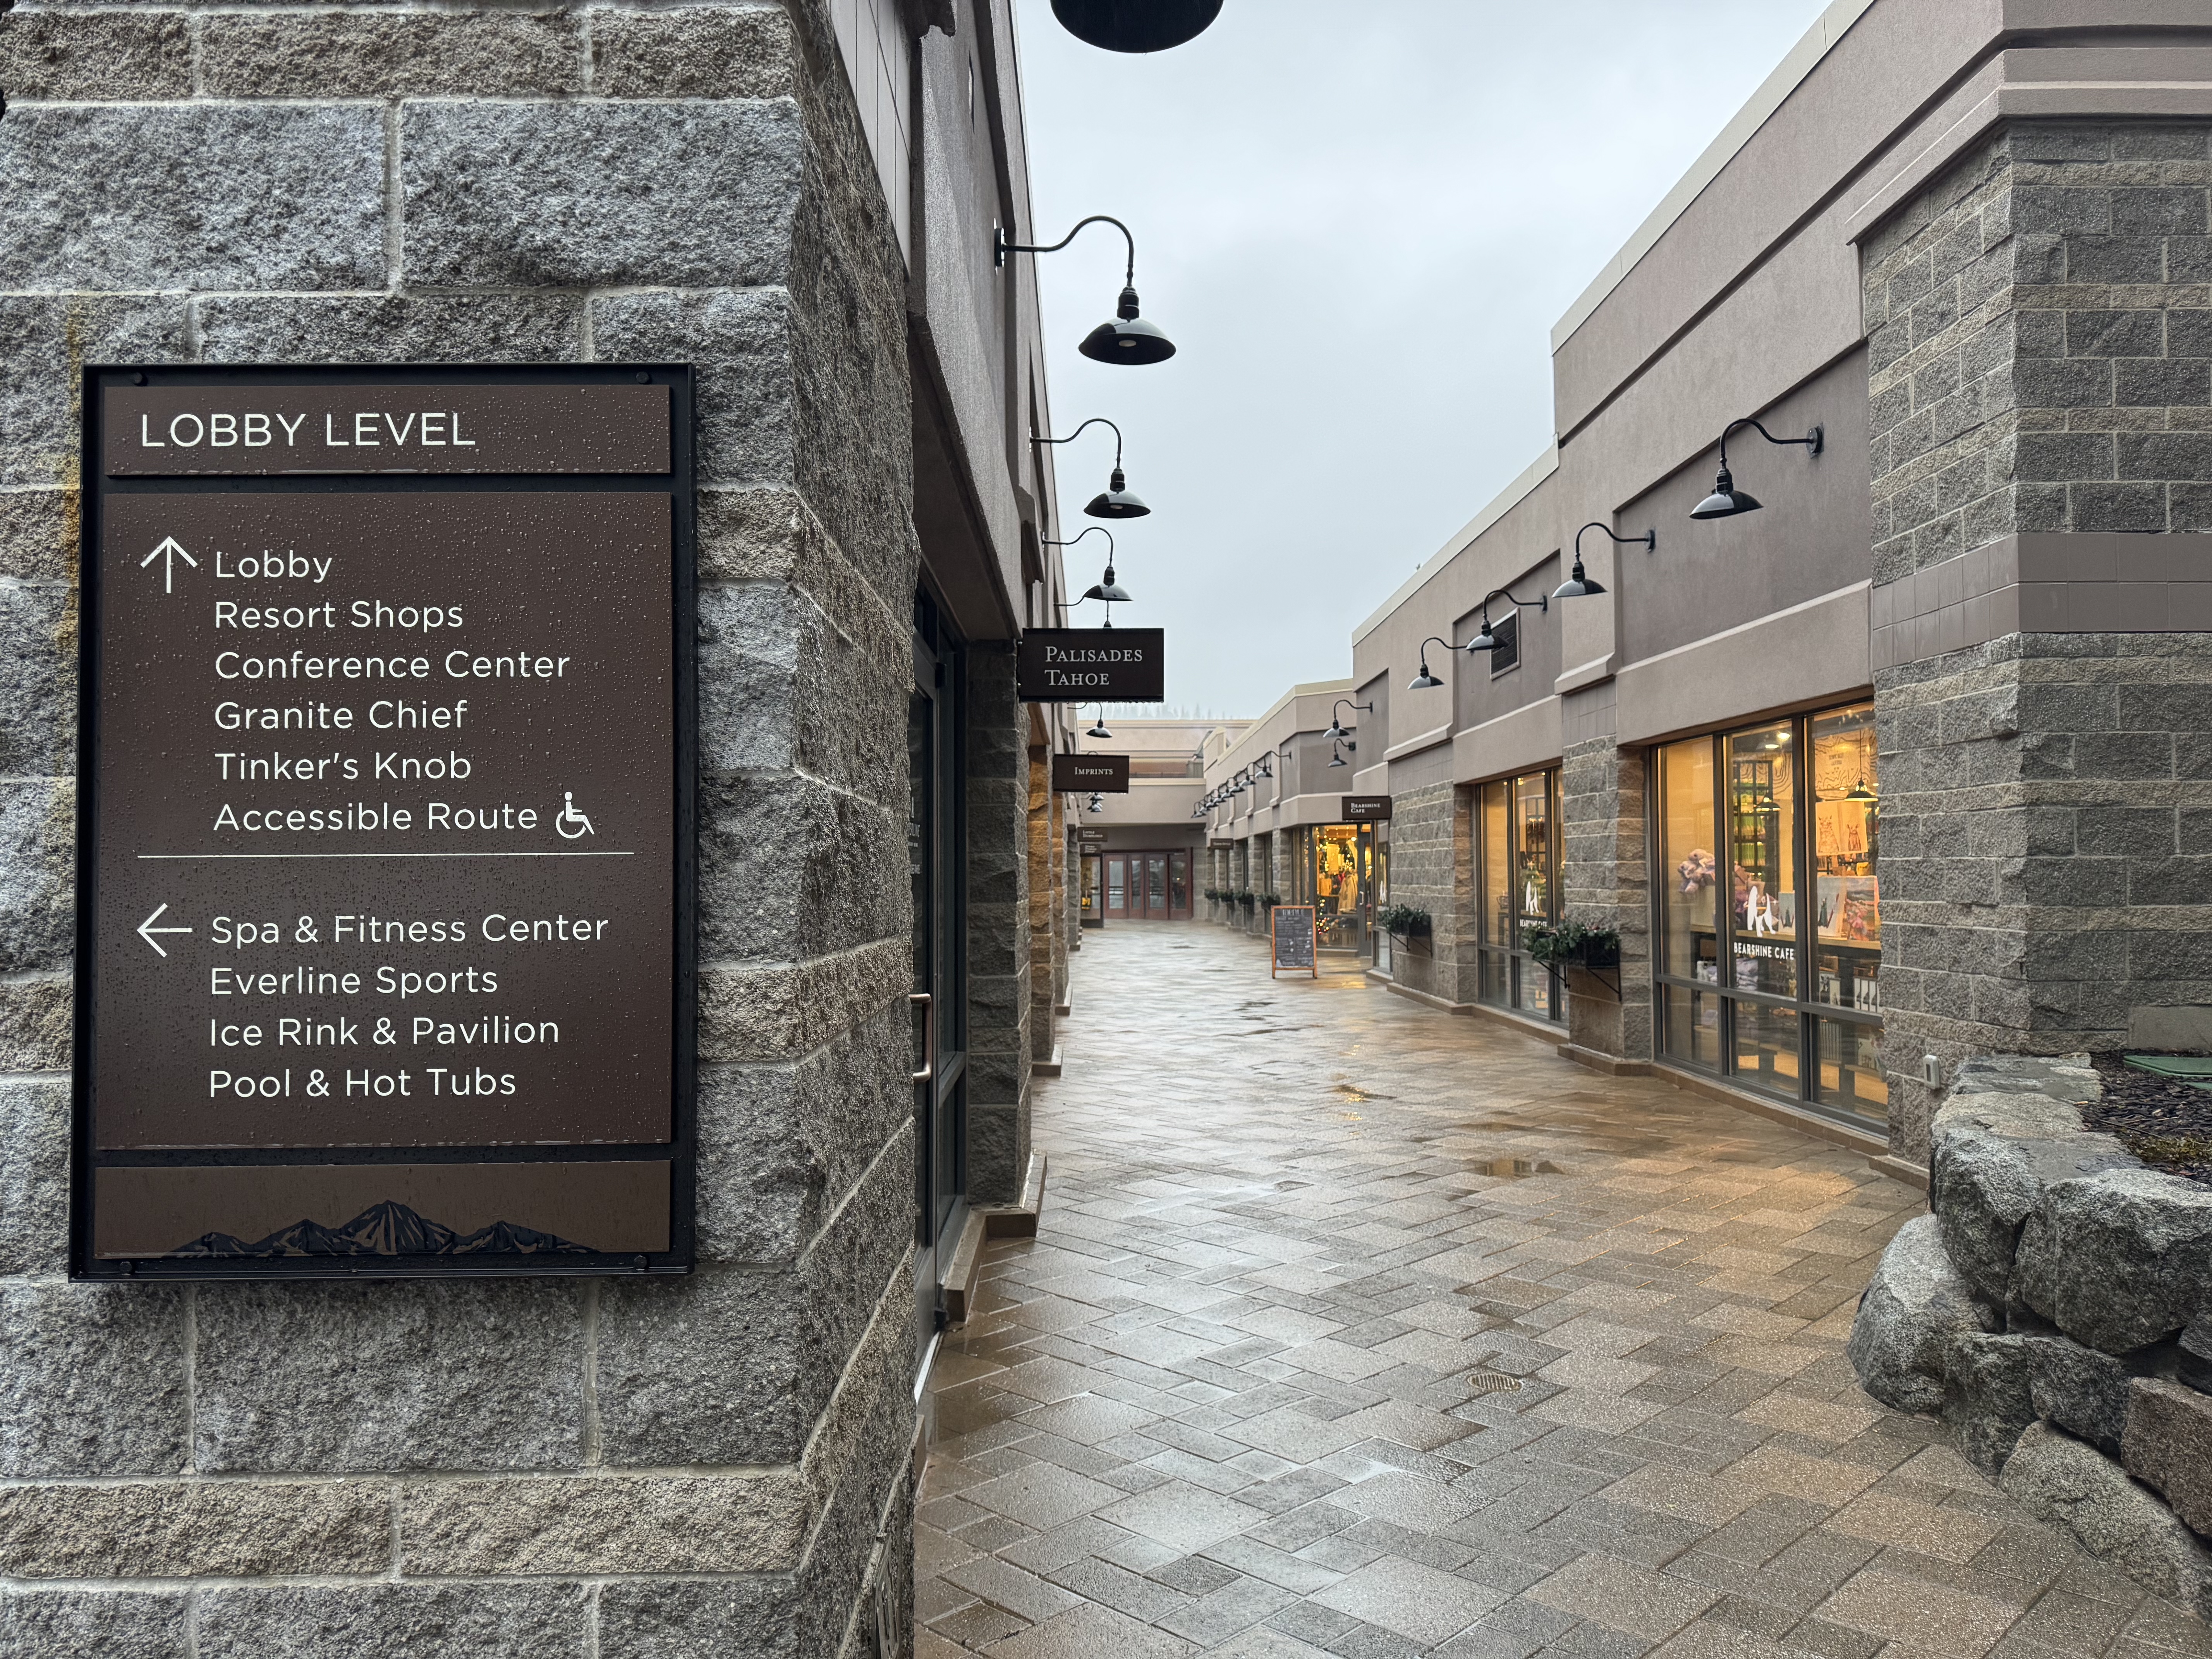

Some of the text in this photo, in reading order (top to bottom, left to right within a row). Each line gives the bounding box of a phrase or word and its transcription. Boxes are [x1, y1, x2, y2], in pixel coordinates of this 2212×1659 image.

[142, 412, 476, 447] LOBBY LEVEL
[216, 550, 332, 583] Lobby
[216, 600, 463, 633] Resort Shops
[215, 650, 570, 679] Conference Center
[1045, 646, 1142, 662] PALISADES
[1044, 670, 1109, 685] TAHOE
[215, 699, 468, 730] Granite Chief
[215, 750, 471, 780] Tinker's Knob
[1075, 767, 1113, 775] IMPRINTS
[213, 802, 537, 831] Accessible Route
[211, 914, 608, 950] Spa & Fitness Center
[1734, 942, 1795, 960] BEARSHINE CAFE
[212, 966, 497, 999] Everline Sports
[211, 1015, 558, 1046] Ice Rink & Pavilion
[211, 1067, 515, 1097] Pool & Hot Tubs
